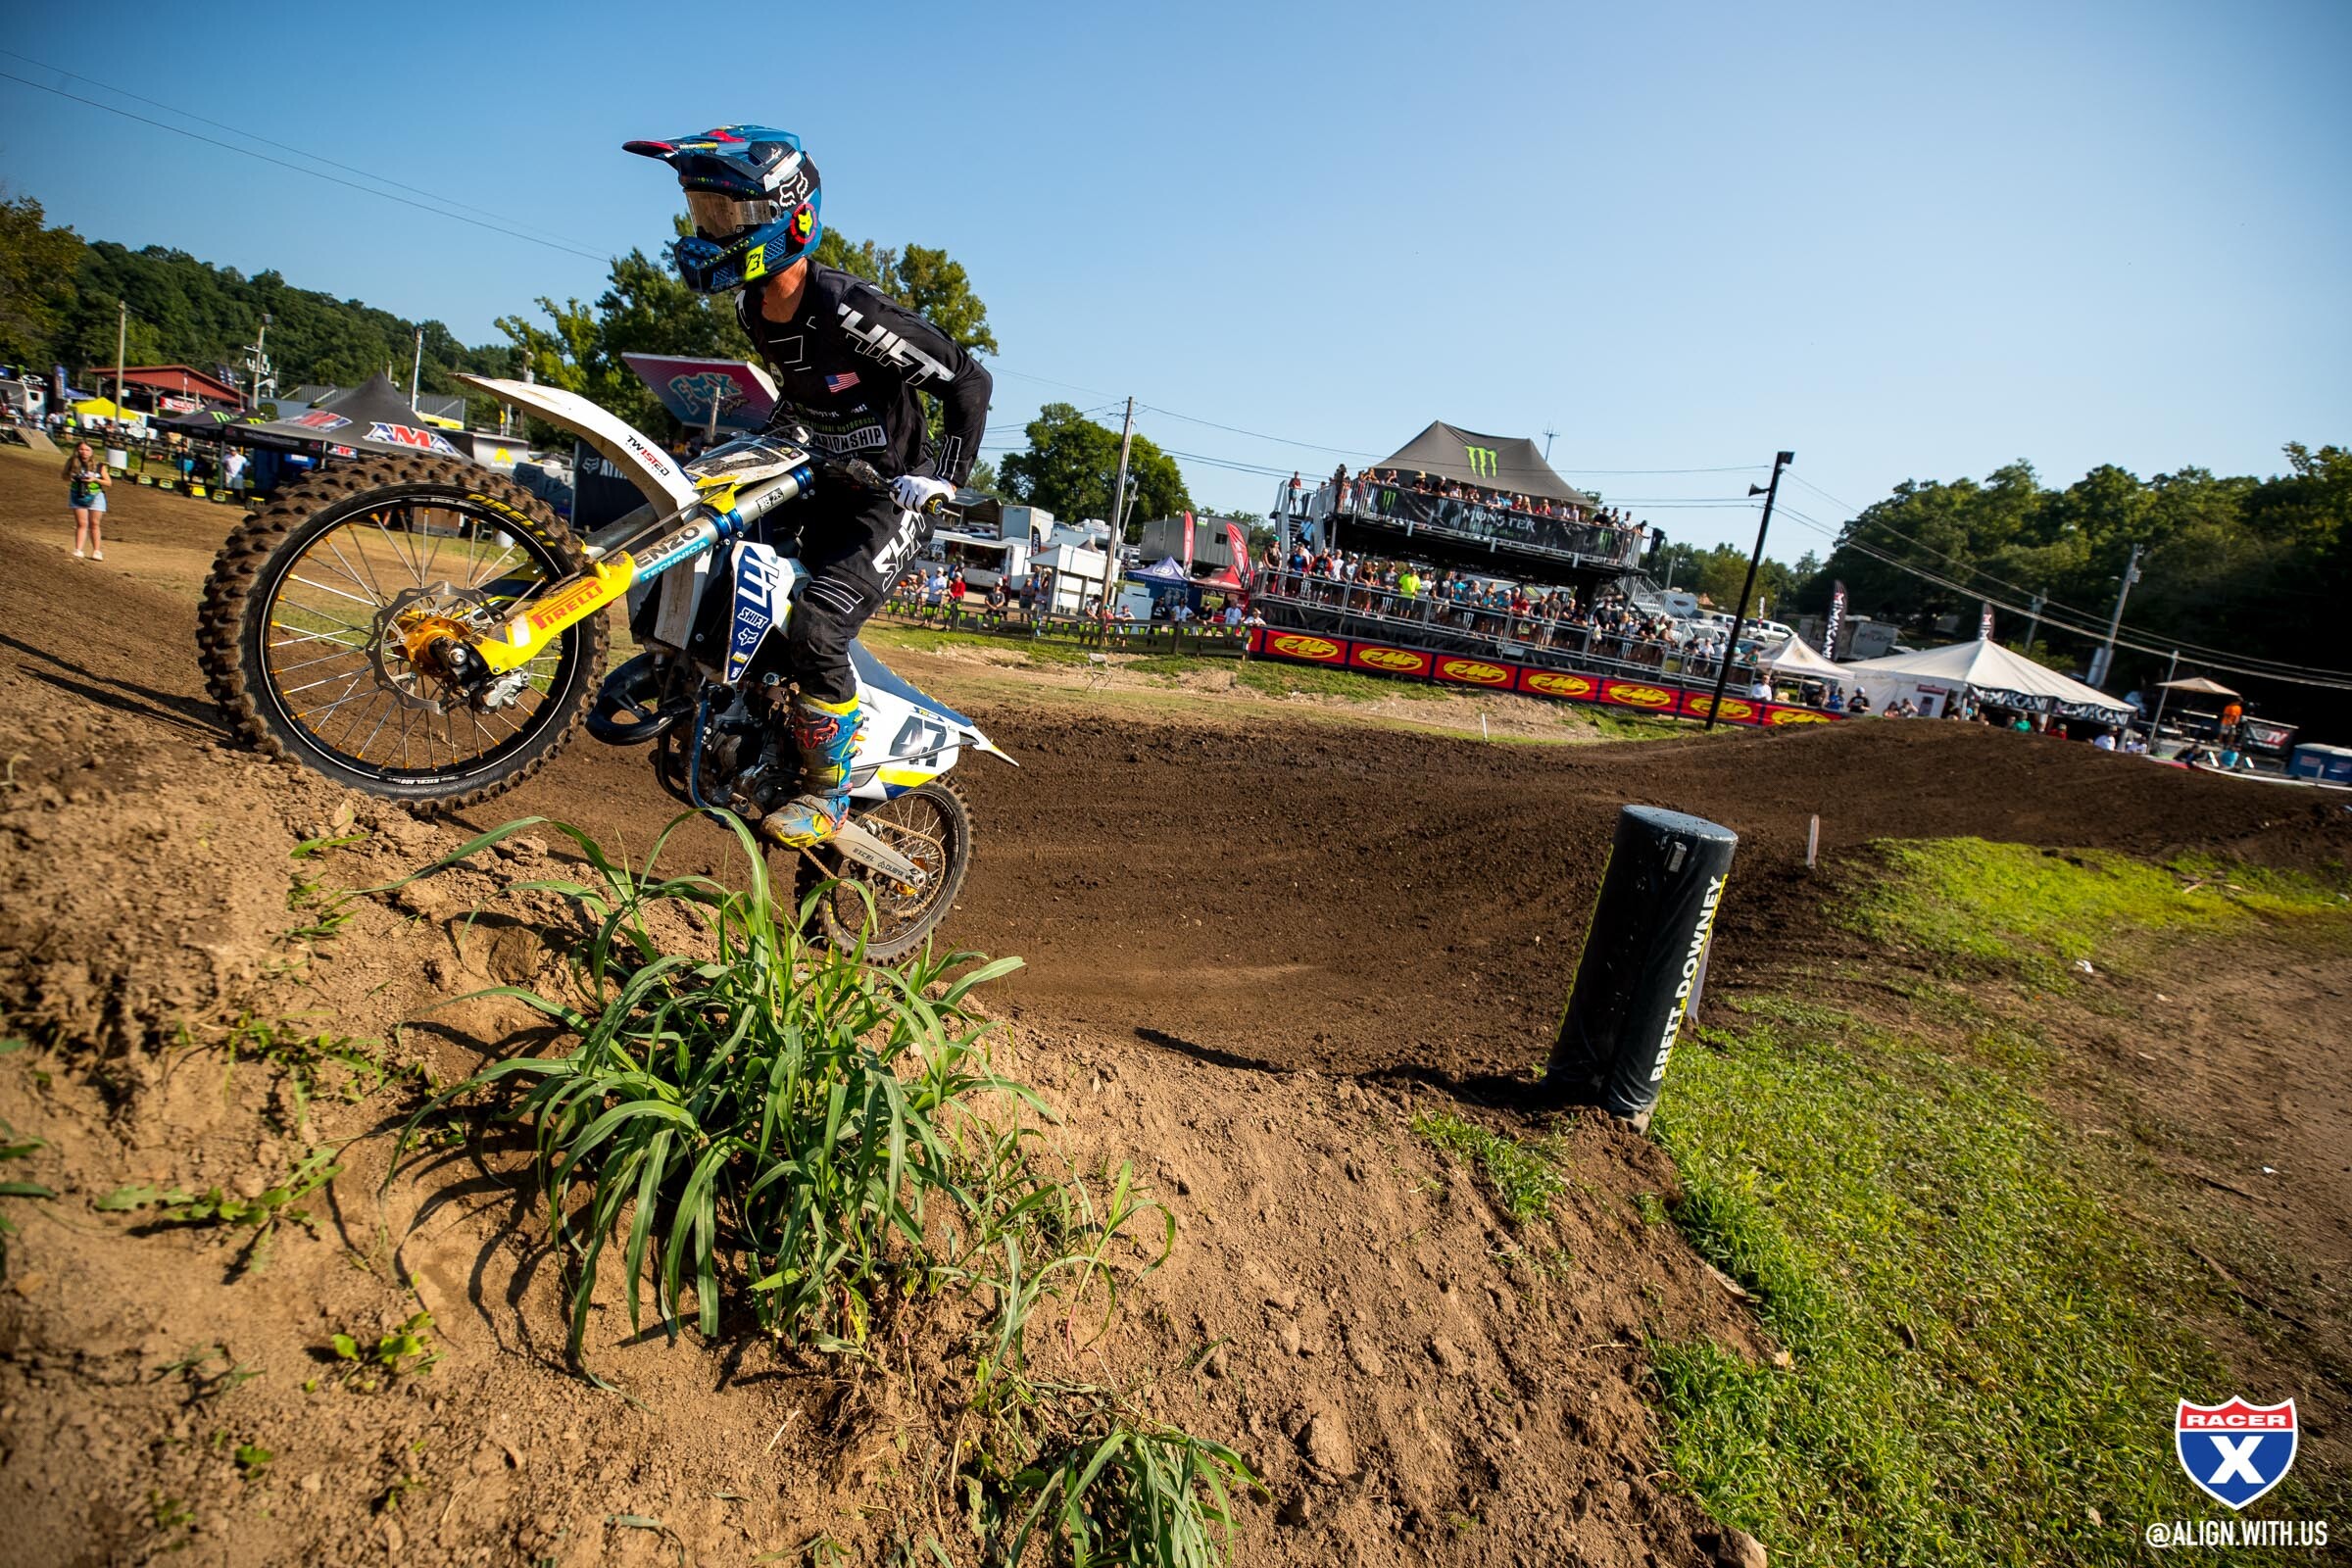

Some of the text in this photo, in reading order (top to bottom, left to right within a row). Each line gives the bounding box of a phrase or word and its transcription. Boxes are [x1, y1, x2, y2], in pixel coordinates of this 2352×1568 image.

[362, 421, 462, 458] AMA
[627, 435, 670, 476] TWISTED
[1462, 508, 1536, 533] MONSTER
[635, 525, 701, 568] ENZO
[643, 541, 708, 579] TECHNICA
[532, 580, 604, 630] PIRELLI
[737, 607, 769, 629] SHIFT
[1274, 636, 1338, 654] FMF
[1358, 649, 1422, 665] FMF
[1444, 661, 1507, 678] FMF
[1529, 674, 1590, 692] FMF
[1609, 686, 1670, 703] FMF
[889, 715, 948, 767] 47
[853, 847, 875, 862] EXCEL
[1675, 875, 1724, 999] DOWNEY
[1649, 1007, 1682, 1082] BRETT
